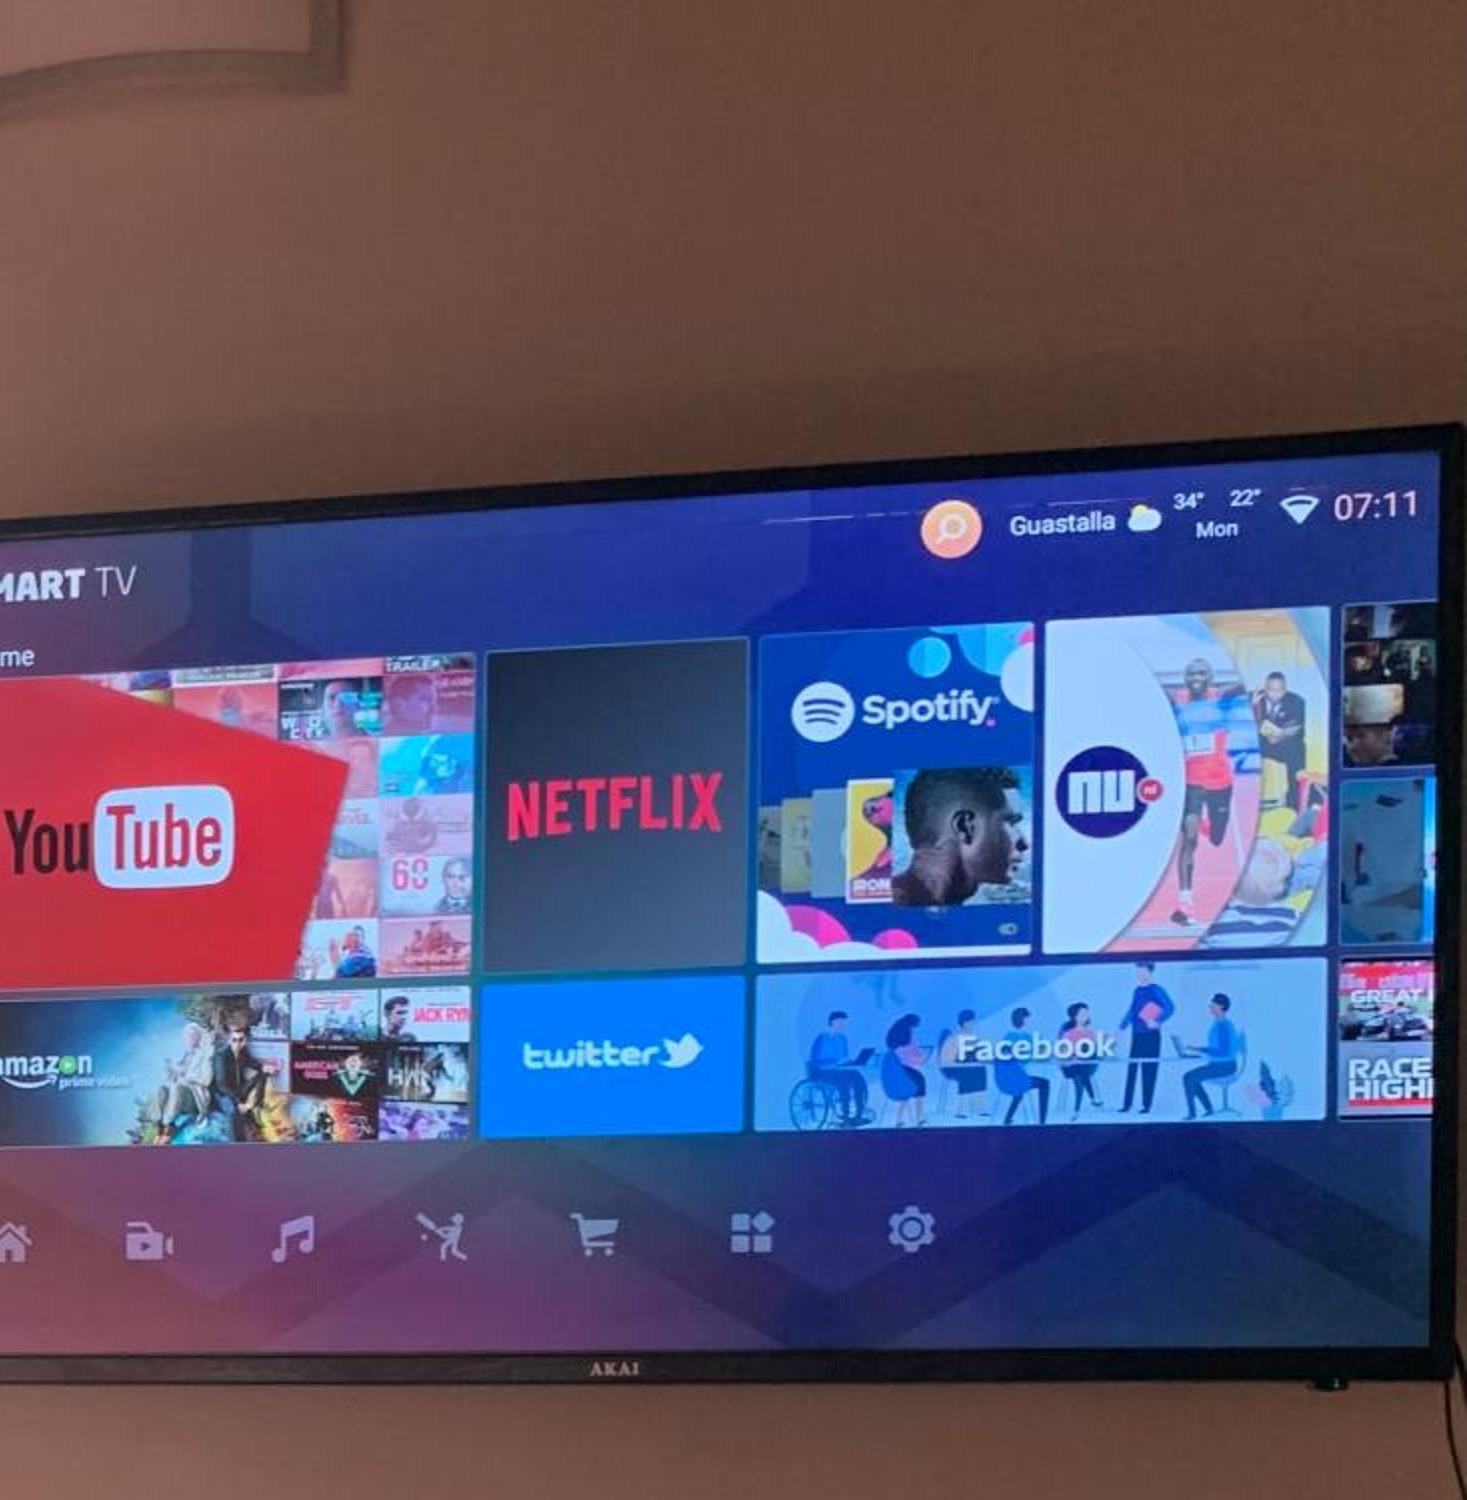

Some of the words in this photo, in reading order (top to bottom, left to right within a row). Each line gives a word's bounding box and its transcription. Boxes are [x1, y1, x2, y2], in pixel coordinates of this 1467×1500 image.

[1334, 490, 1417, 521] 07:11
[1010, 511, 1116, 537] Guastalla
[1196, 520, 1238, 538] Mon
[94, 566, 138, 597] TV
[507, 771, 723, 841] NETFLIX
[1350, 988, 1424, 1003] GREAT
[522, 1039, 661, 1070] twitter
[958, 1030, 1116, 1062] Facebook
[1349, 1057, 1432, 1079] RACE
[590, 1361, 640, 1377] AKAI
